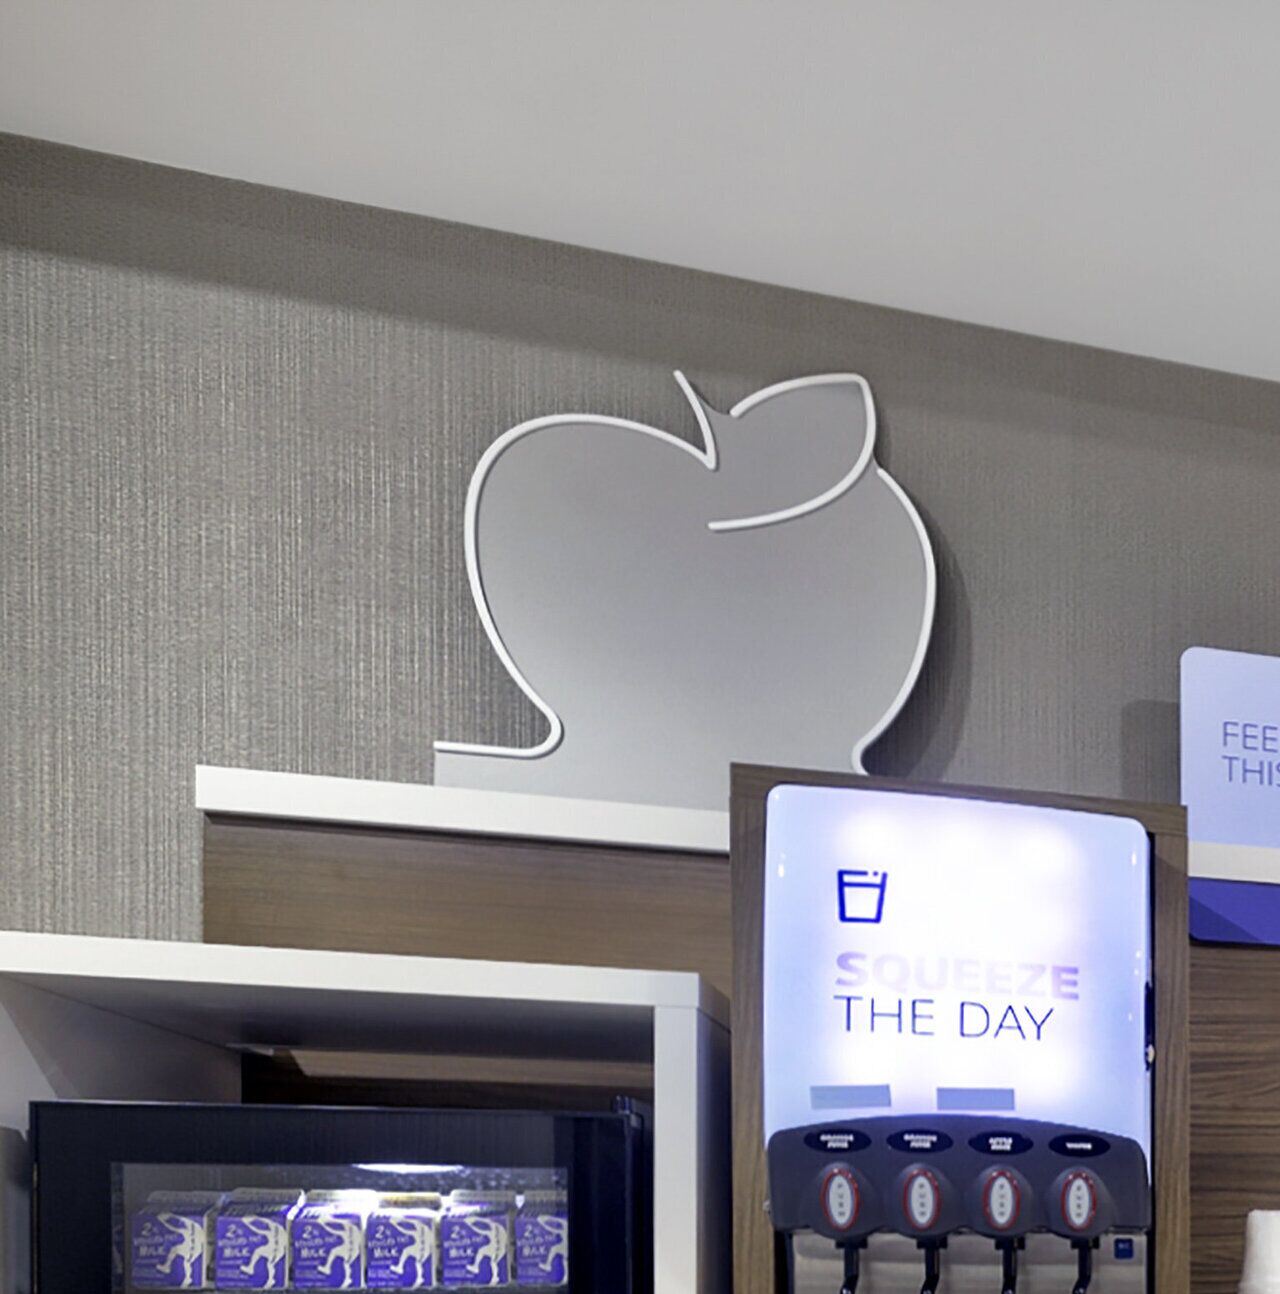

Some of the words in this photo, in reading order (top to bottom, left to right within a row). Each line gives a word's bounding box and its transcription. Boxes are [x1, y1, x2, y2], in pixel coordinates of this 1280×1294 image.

[835, 951, 1080, 1001] SQUEEZE
[833, 994, 935, 1036] THE
[959, 1001, 1054, 1041] DAY
